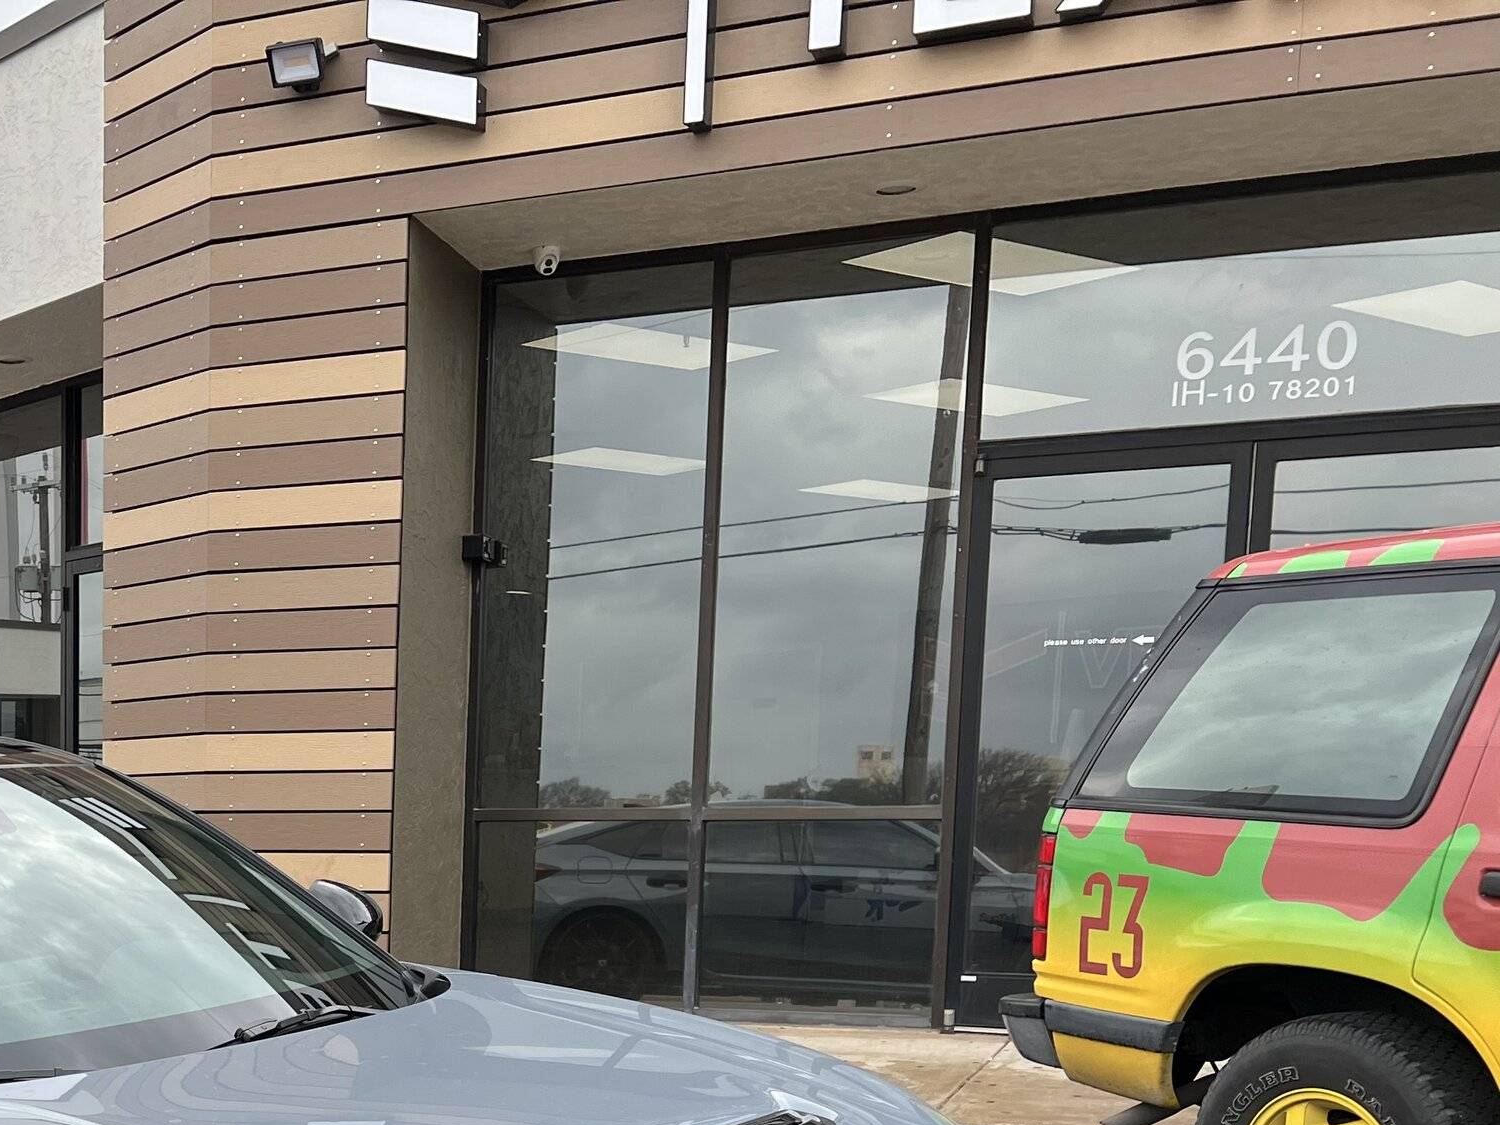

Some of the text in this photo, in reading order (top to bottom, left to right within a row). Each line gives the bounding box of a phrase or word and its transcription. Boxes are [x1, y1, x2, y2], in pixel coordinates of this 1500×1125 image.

[1175, 319, 1358, 381] 6440
[1171, 375, 1357, 407] IH-10 78201
[1043, 638, 1069, 648] please
[1087, 636, 1107, 645] other
[1109, 636, 1127, 644] door
[1078, 871, 1150, 979] 23
